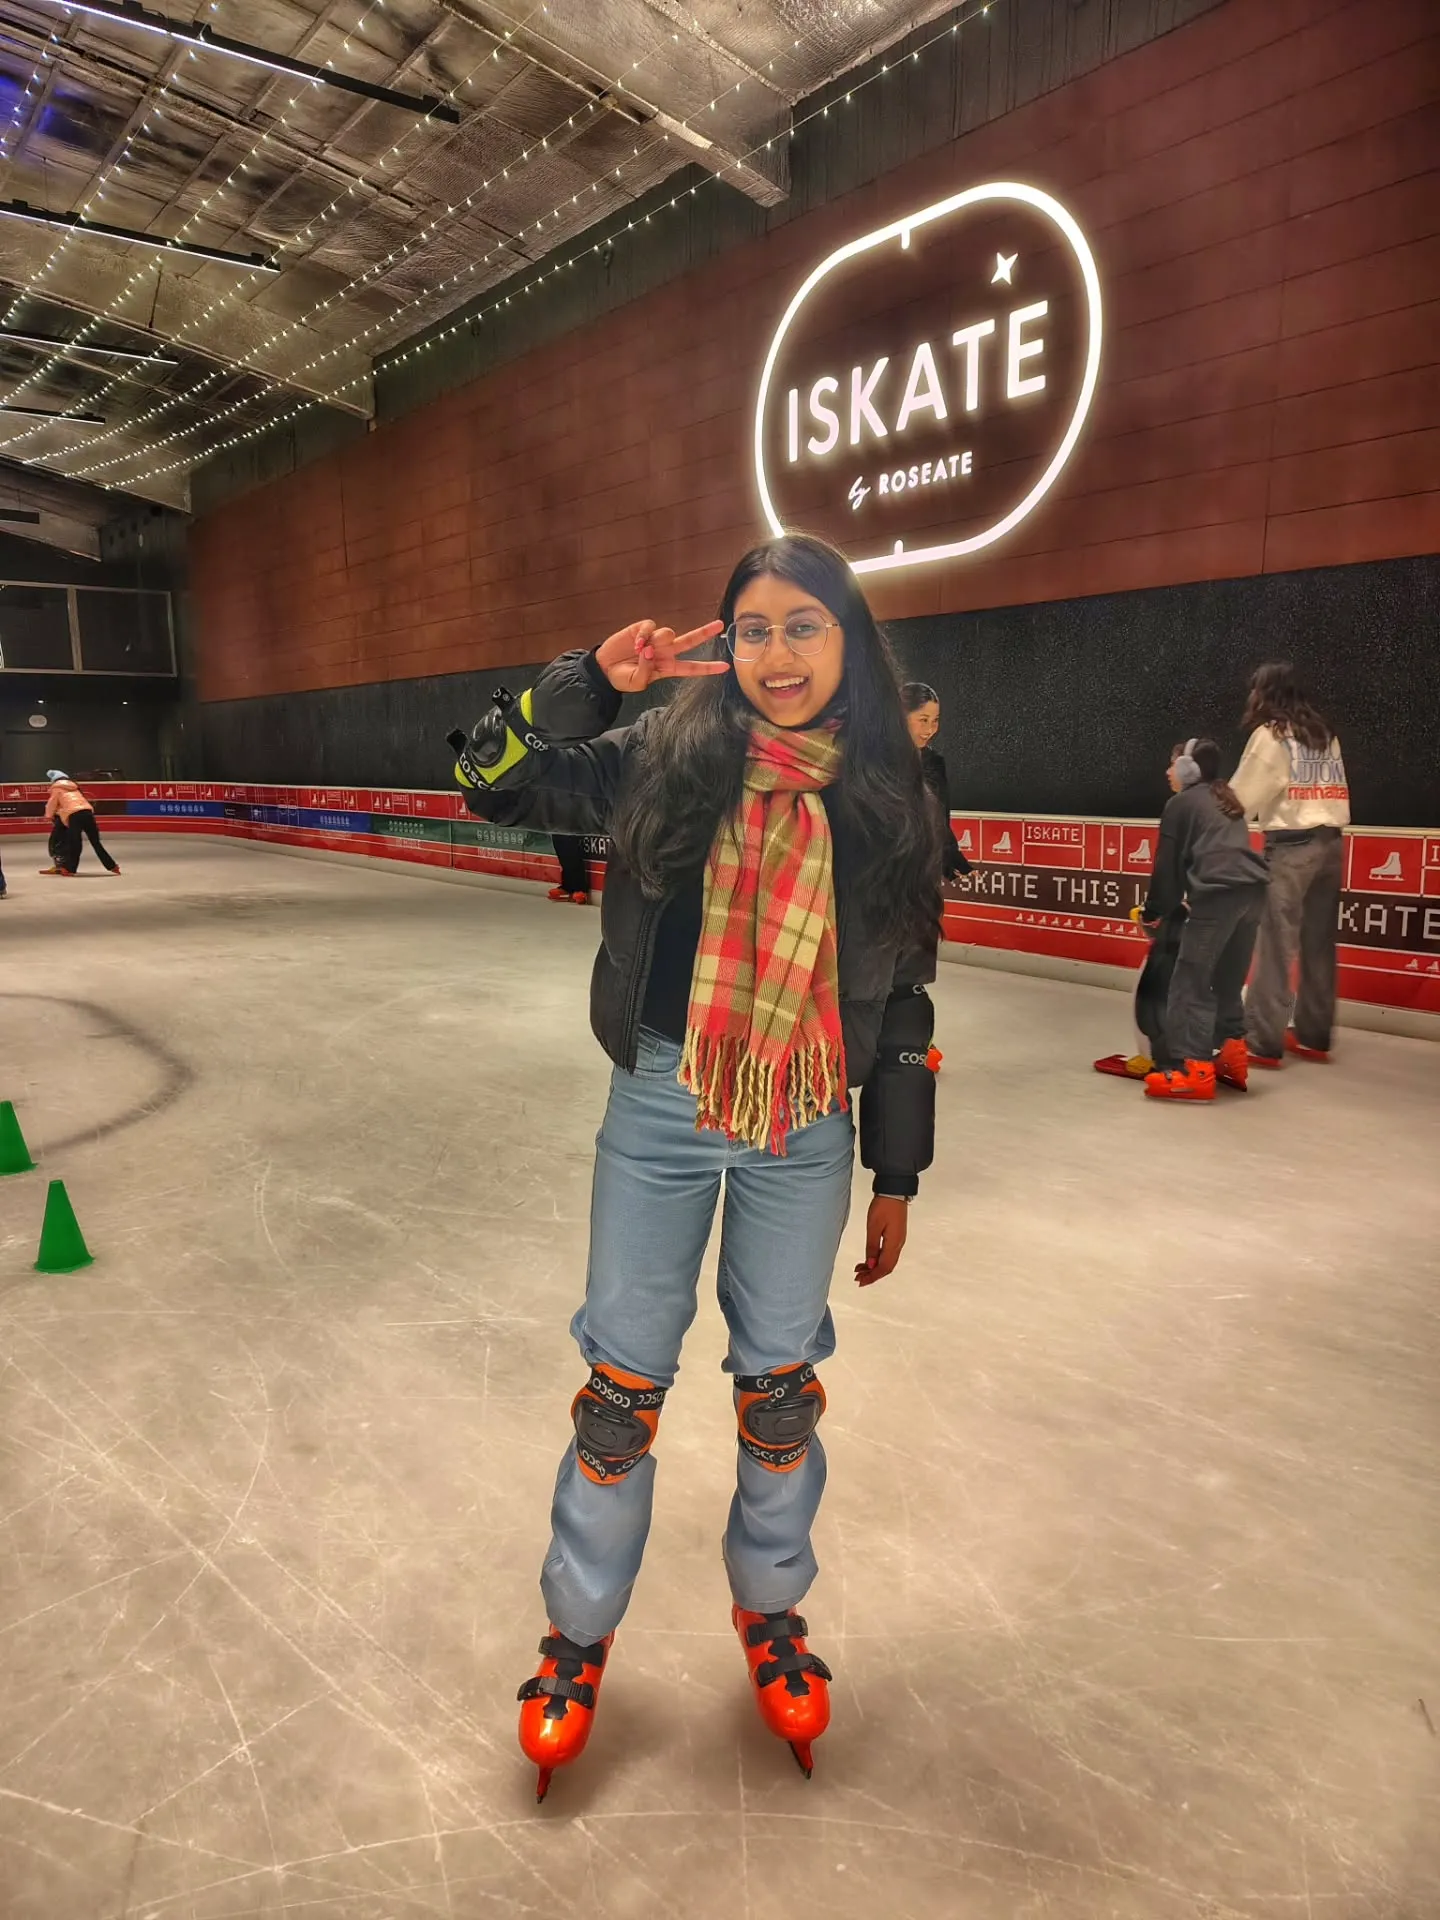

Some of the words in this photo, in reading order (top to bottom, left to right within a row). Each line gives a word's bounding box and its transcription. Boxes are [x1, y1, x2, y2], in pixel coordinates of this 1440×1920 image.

[788, 300, 1049, 463] ISKATE
[848, 476, 872, 510] by
[878, 451, 973, 496] ROSEATE
[524, 732, 550, 752] COS
[459, 752, 491, 790] COSC
[583, 836, 610, 855] SKA
[1026, 826, 1081, 843] ISKATE
[1052, 876, 1120, 907] THIS
[1337, 900, 1440, 939] KATE
[899, 1051, 926, 1065] COS
[592, 1377, 631, 1408] COSCO
